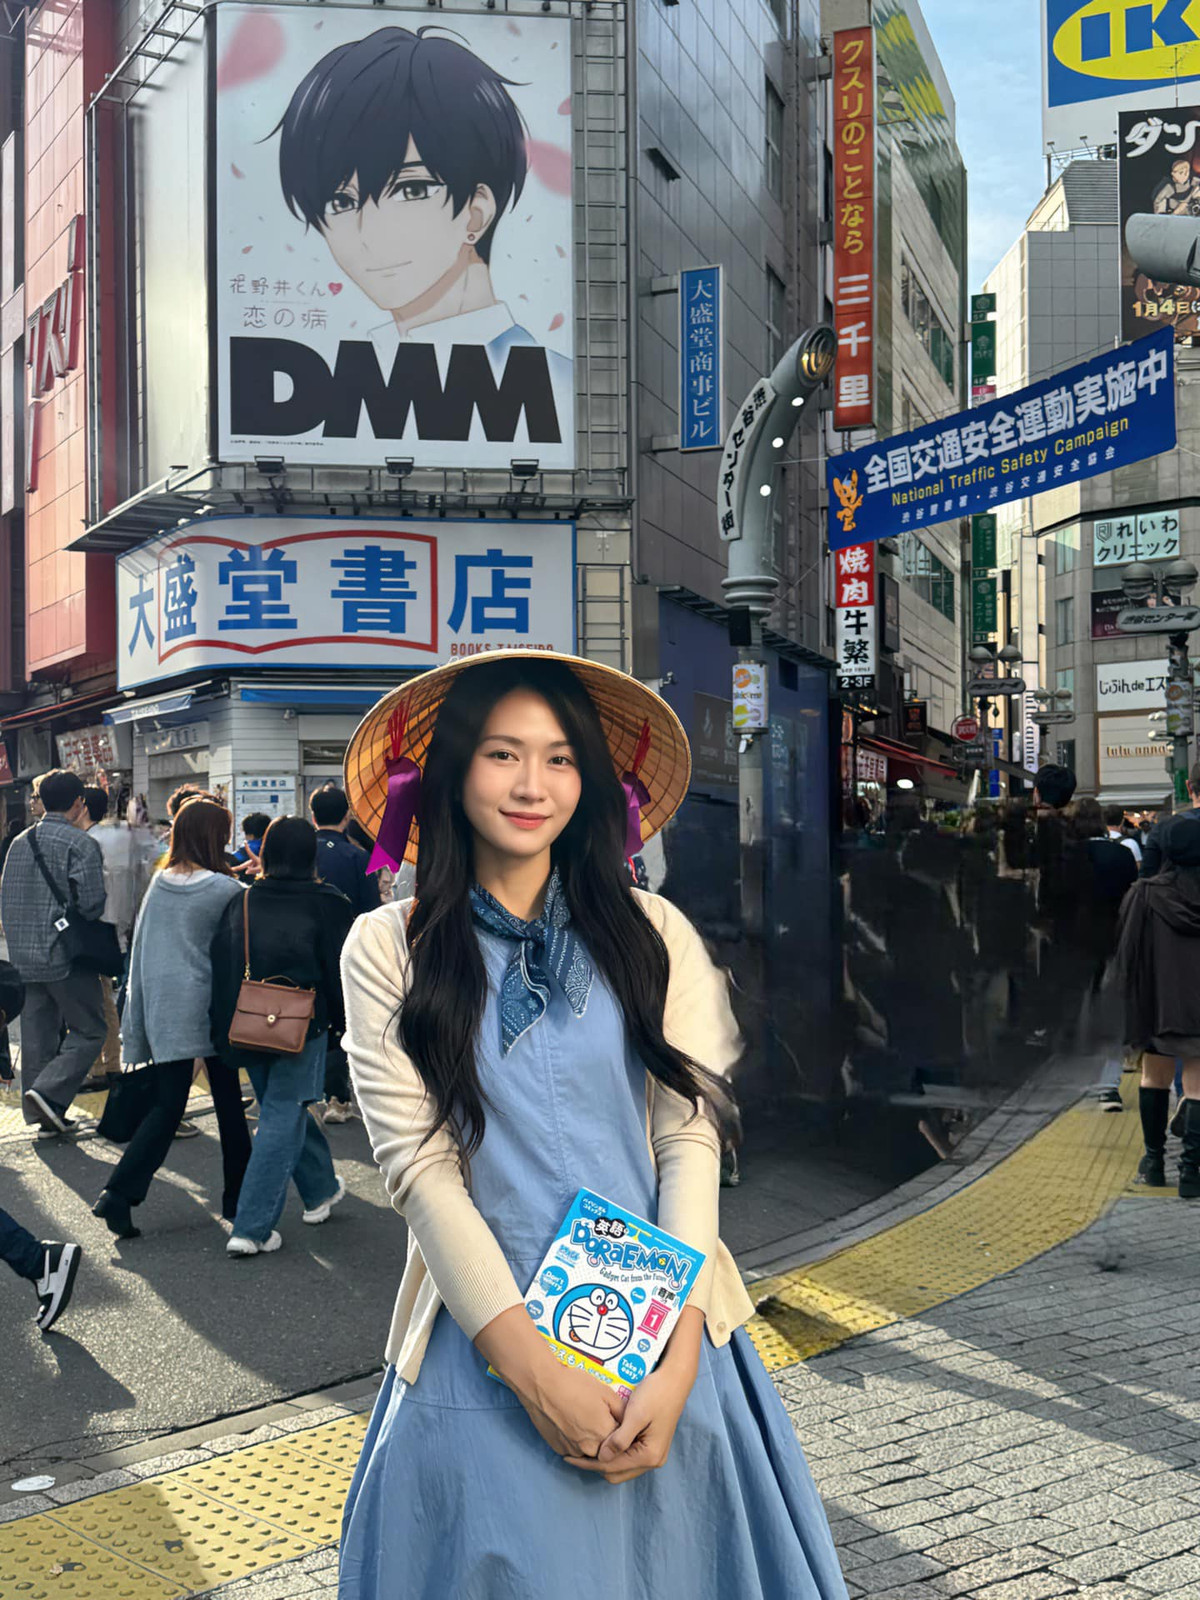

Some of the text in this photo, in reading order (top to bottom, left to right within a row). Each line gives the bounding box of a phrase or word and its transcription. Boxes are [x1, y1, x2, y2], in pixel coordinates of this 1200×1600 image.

[837, 40, 871, 408] クスリのことなら 三千里
[243, 305, 328, 331] 恋の病
[689, 278, 714, 440] 大盛堂商事ビル
[230, 336, 562, 444] DMM
[864, 347, 1167, 494] 全国交通安全運動実施中
[891, 417, 1129, 507] National Traffic Safety Campaign
[1097, 538, 1178, 562] クリニック
[1116, 516, 1178, 539] れいわ
[128, 544, 534, 657] 大盛堂書店
[839, 547, 871, 604] 焼肉
[450, 642, 492, 656] BOOKS
[843, 610, 869, 665] 牛繁
[650, 1313, 659, 1328] 1
[621, 1367, 638, 1380] easy.
[622, 1358, 637, 1371] Take
